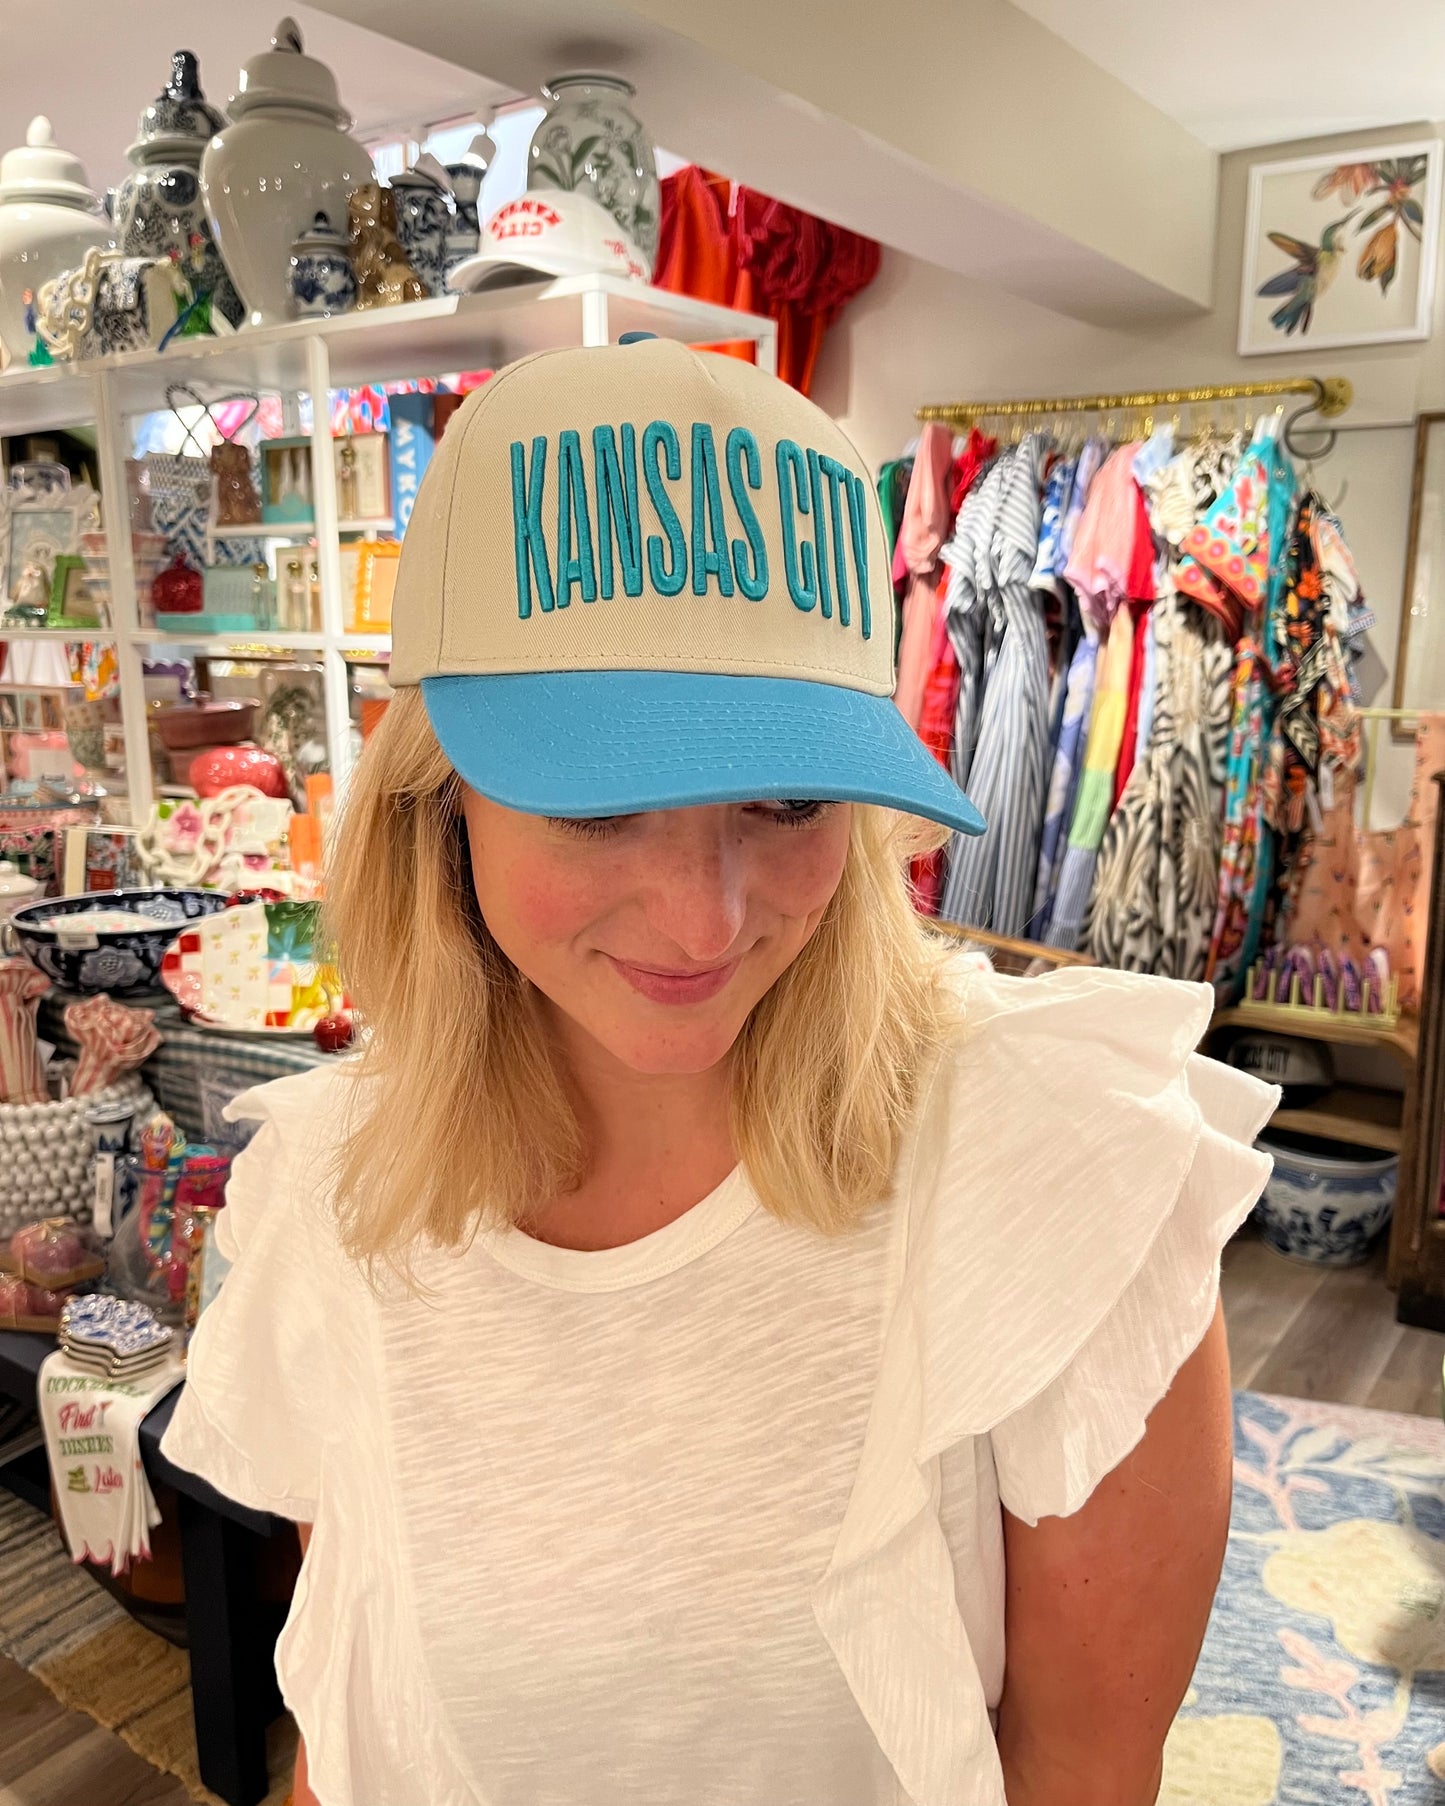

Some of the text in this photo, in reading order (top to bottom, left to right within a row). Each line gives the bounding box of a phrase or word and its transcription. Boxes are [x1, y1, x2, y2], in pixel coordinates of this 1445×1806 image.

[395, 418, 417, 541] MY KO
[510, 420, 871, 640] KANSAS CITY
[58, 1401, 97, 1432] First
[60, 1435, 113, 1456] DISHES
